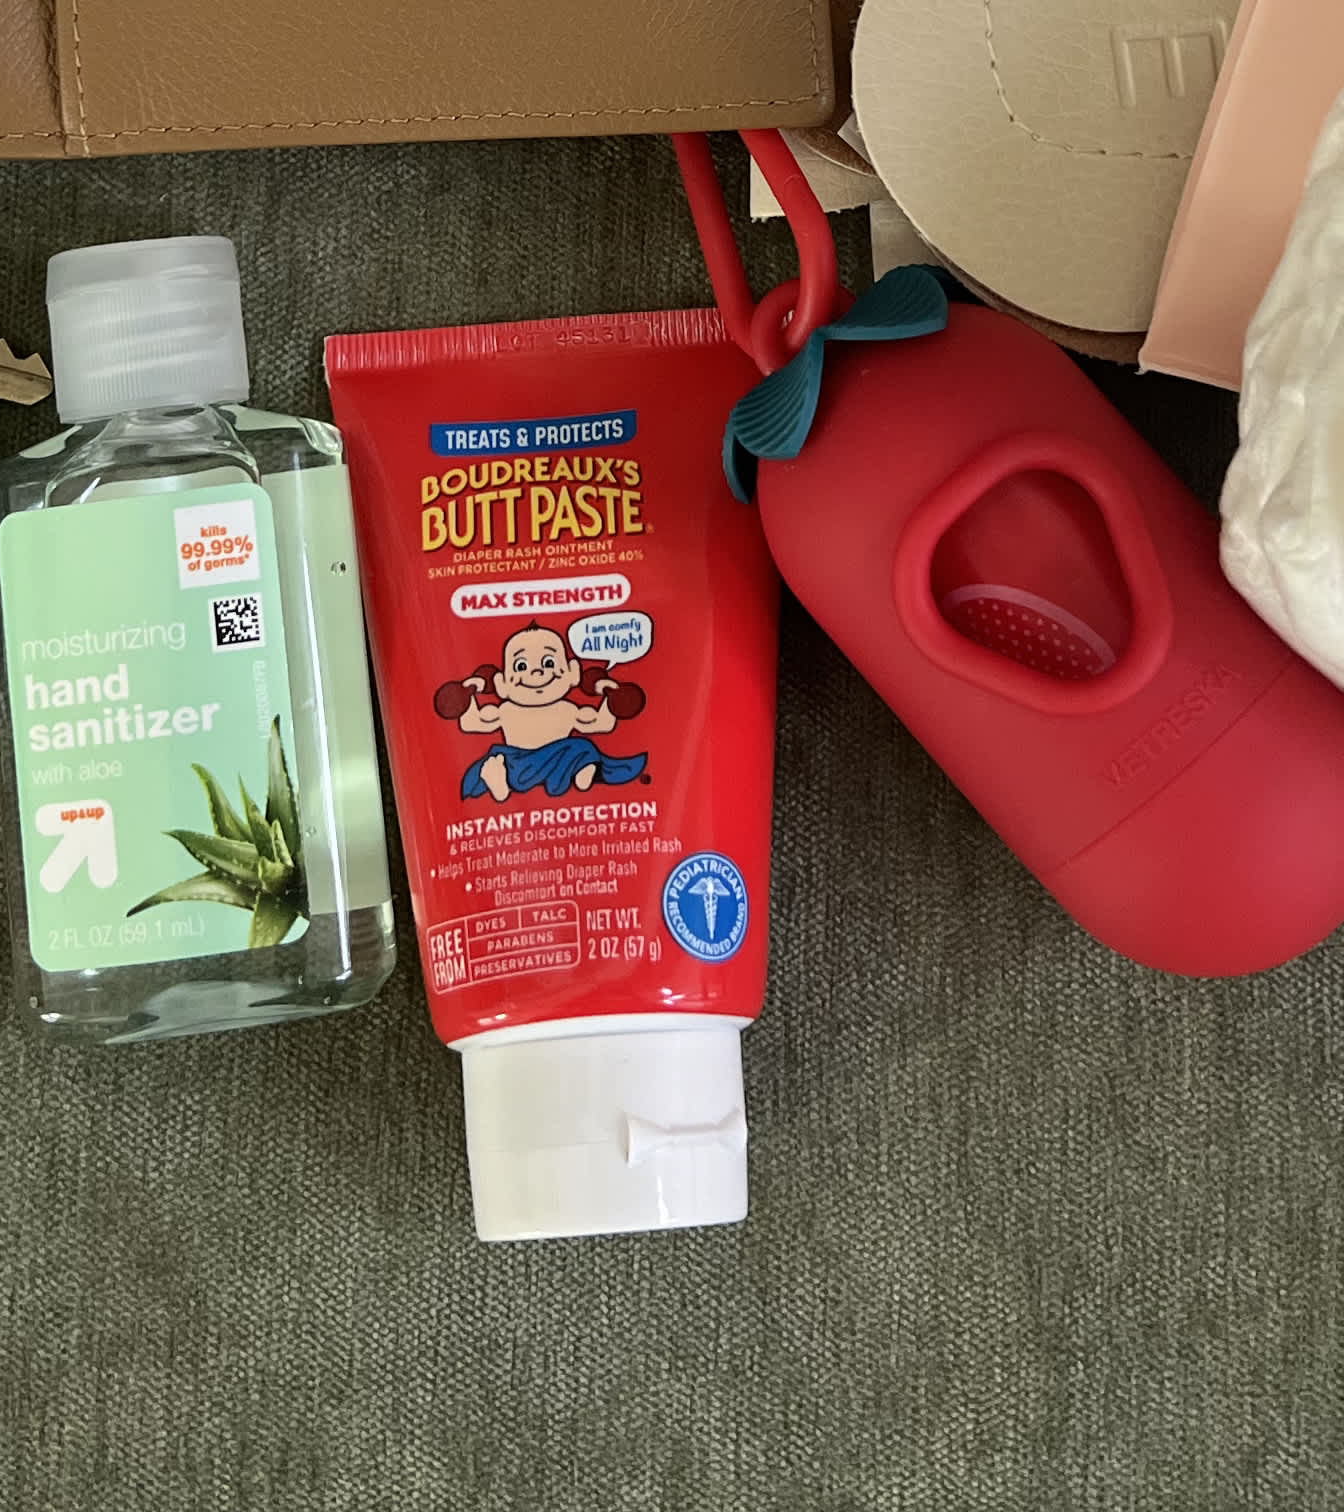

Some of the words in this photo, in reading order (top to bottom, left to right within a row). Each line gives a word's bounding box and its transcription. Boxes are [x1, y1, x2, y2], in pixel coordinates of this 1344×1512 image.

[446, 428, 511, 450] TREATS
[516, 427, 529, 448] &
[535, 418, 624, 446] PROTECTS
[421, 455, 641, 505] BOUDREAUX'S
[200, 525, 227, 537] kills
[422, 486, 525, 552] BUTT
[531, 485, 645, 542] PASTE
[180, 535, 254, 560] 99.99%
[453, 548, 502, 563] DIAPER
[506, 546, 542, 559] RASH
[545, 540, 613, 556] OINTMENT
[187, 559, 201, 572] of
[428, 566, 456, 580] SKIN
[458, 559, 537, 576] PROTECTANT
[548, 555, 576, 569] ZINC
[578, 552, 616, 566] OXIDE
[618, 548, 644, 563] 40%
[461, 591, 508, 611] MAX
[513, 584, 623, 607] STRENGTH
[22, 619, 186, 662] moisturizing
[591, 625, 606, 634] am
[608, 619, 641, 634] comfy
[581, 637, 601, 653] All
[604, 634, 644, 653] Night
[24, 663, 130, 710] hand
[28, 702, 221, 752] sanitizer
[31, 763, 72, 785] with
[79, 758, 123, 781] aloe
[446, 812, 525, 840] INSTANT
[530, 801, 657, 827] PROTECTION
[460, 833, 521, 853] RELIEVES
[524, 822, 616, 843] DISCOMFORT
[620, 820, 655, 834] FAST
[438, 861, 464, 879] Helps
[466, 856, 494, 873] Treat
[496, 845, 550, 867] Moderate
[554, 845, 566, 859] to
[568, 840, 599, 858] More
[602, 836, 650, 855] Irritated
[653, 835, 683, 853] Rash
[475, 875, 507, 893] Starts
[510, 868, 563, 888] Relieving
[566, 864, 605, 883] Diaper
[608, 860, 638, 877] Rash
[669, 859, 743, 900] PEDIATRICIAN
[494, 884, 556, 907] Discomfort
[559, 884, 574, 897] on
[576, 878, 618, 896] Contact
[475, 916, 506, 933] DYES
[532, 908, 568, 922] TALC
[586, 909, 612, 931] NET
[615, 907, 642, 930] WT.
[668, 901, 732, 955] RECOMMENDED
[48, 929, 60, 951] 2
[89, 924, 113, 946] OZ
[430, 928, 464, 961] FREE
[487, 931, 554, 952] PARABENS
[588, 937, 597, 960] 2
[599, 936, 619, 959] OZ
[623, 936, 645, 960] (57
[648, 934, 662, 962] g)
[433, 955, 467, 987] FROM
[474, 950, 572, 978] PRESERVATIVES
